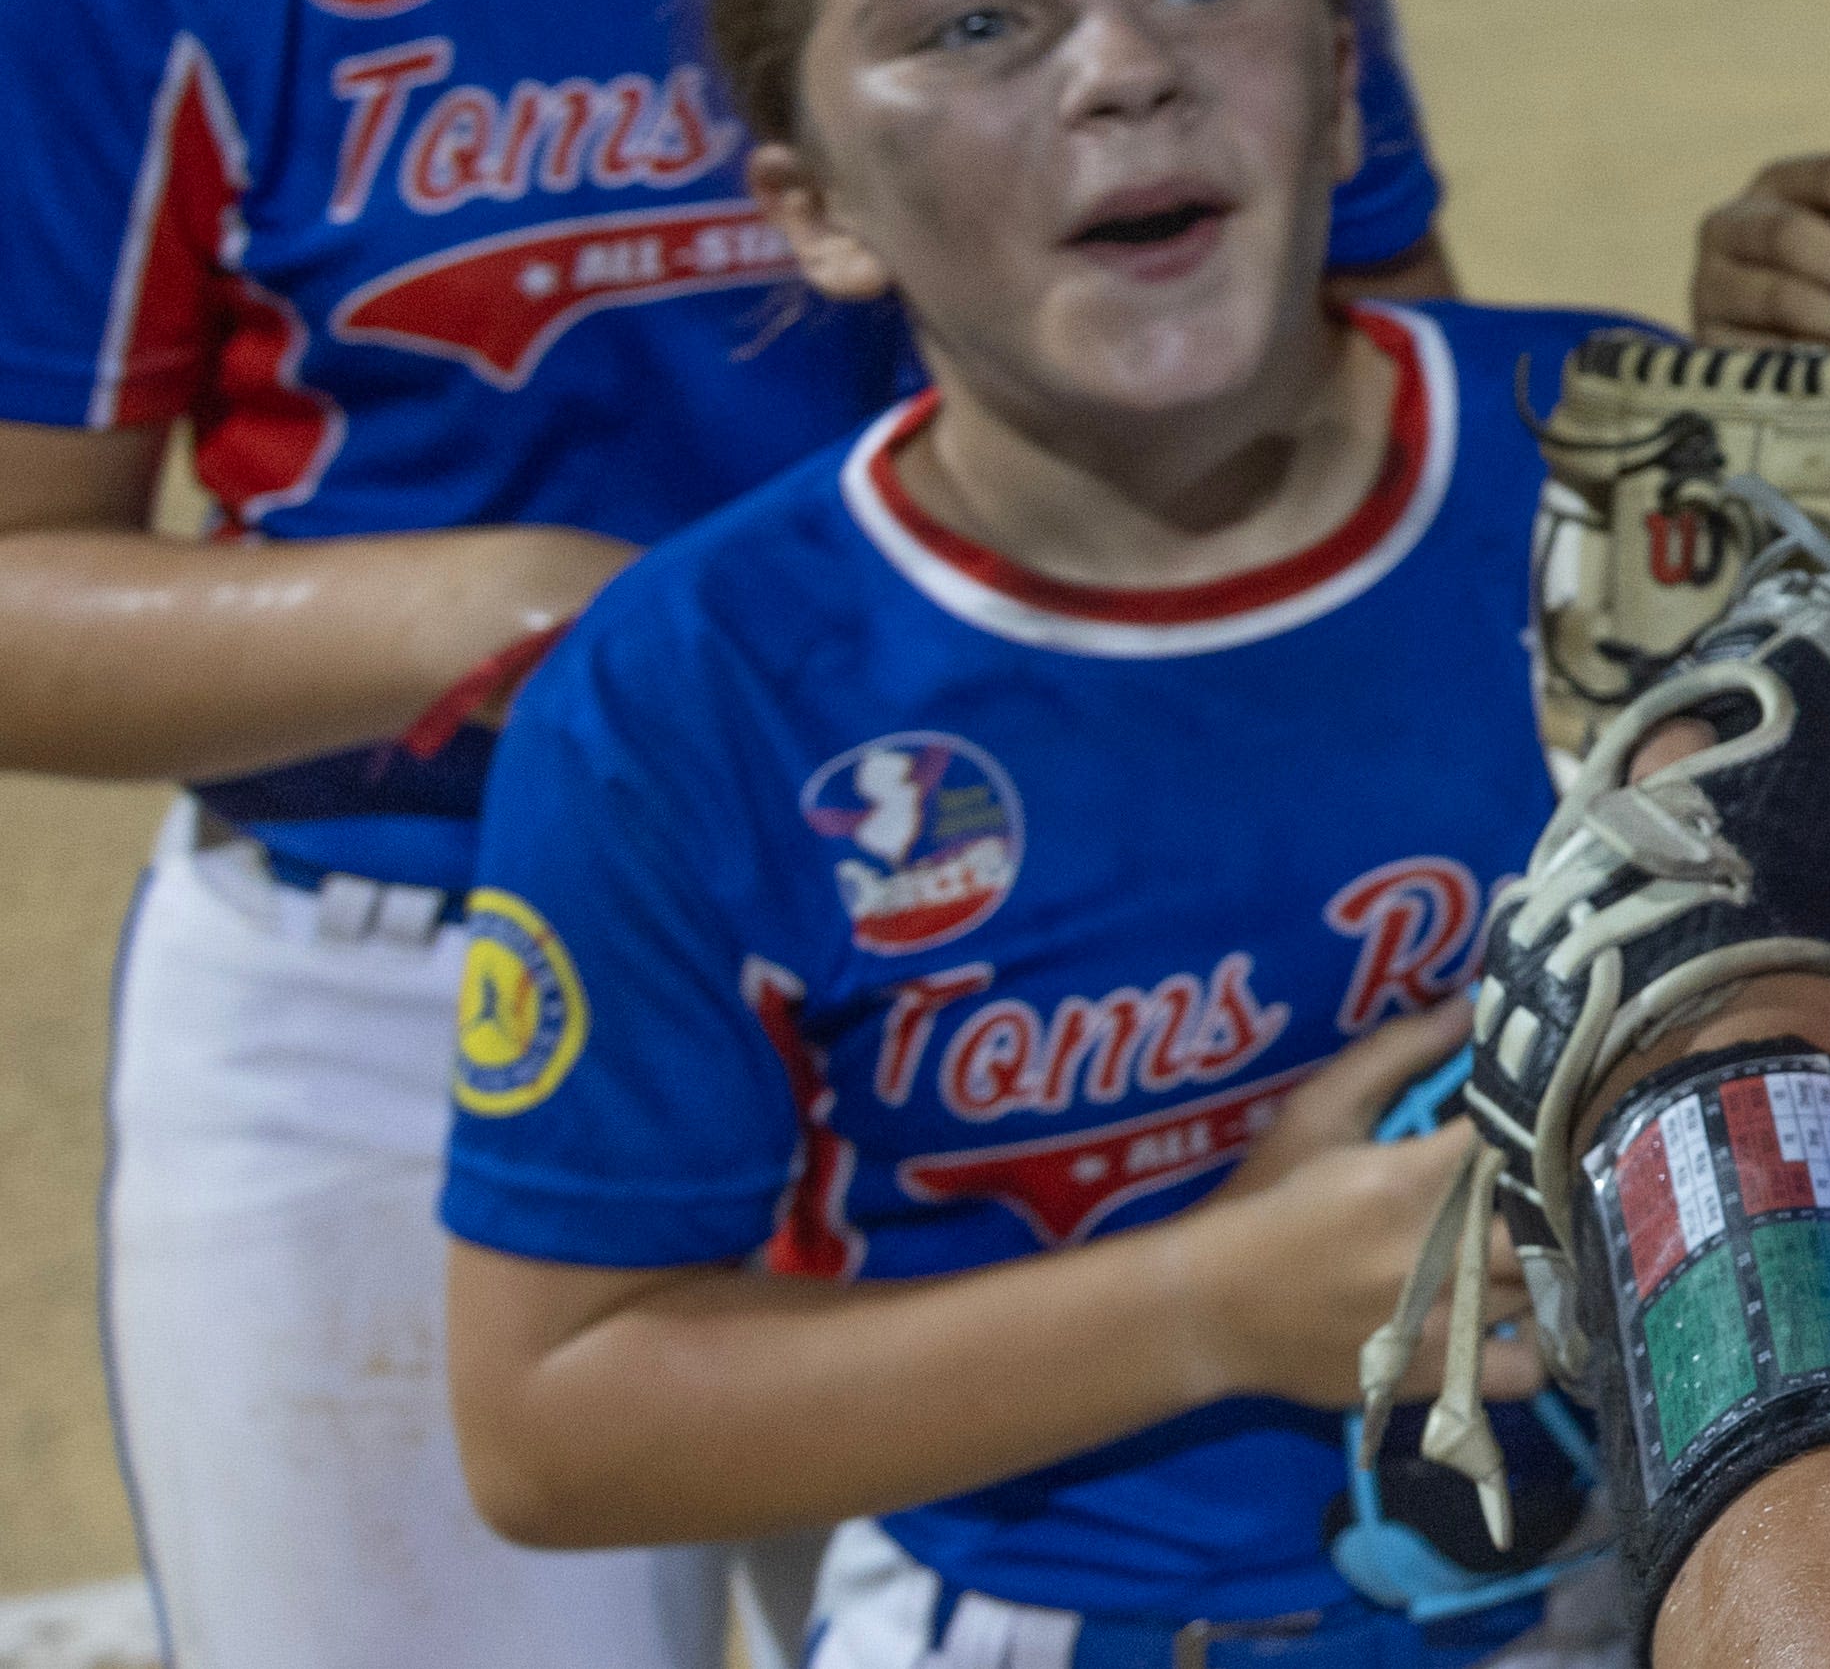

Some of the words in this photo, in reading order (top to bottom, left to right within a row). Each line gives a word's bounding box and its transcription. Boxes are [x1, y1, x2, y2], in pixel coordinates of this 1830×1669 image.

[326, 35, 744, 224] Toms
[876, 951, 1290, 1124] Toms
[1322, 854, 1505, 1036] R
